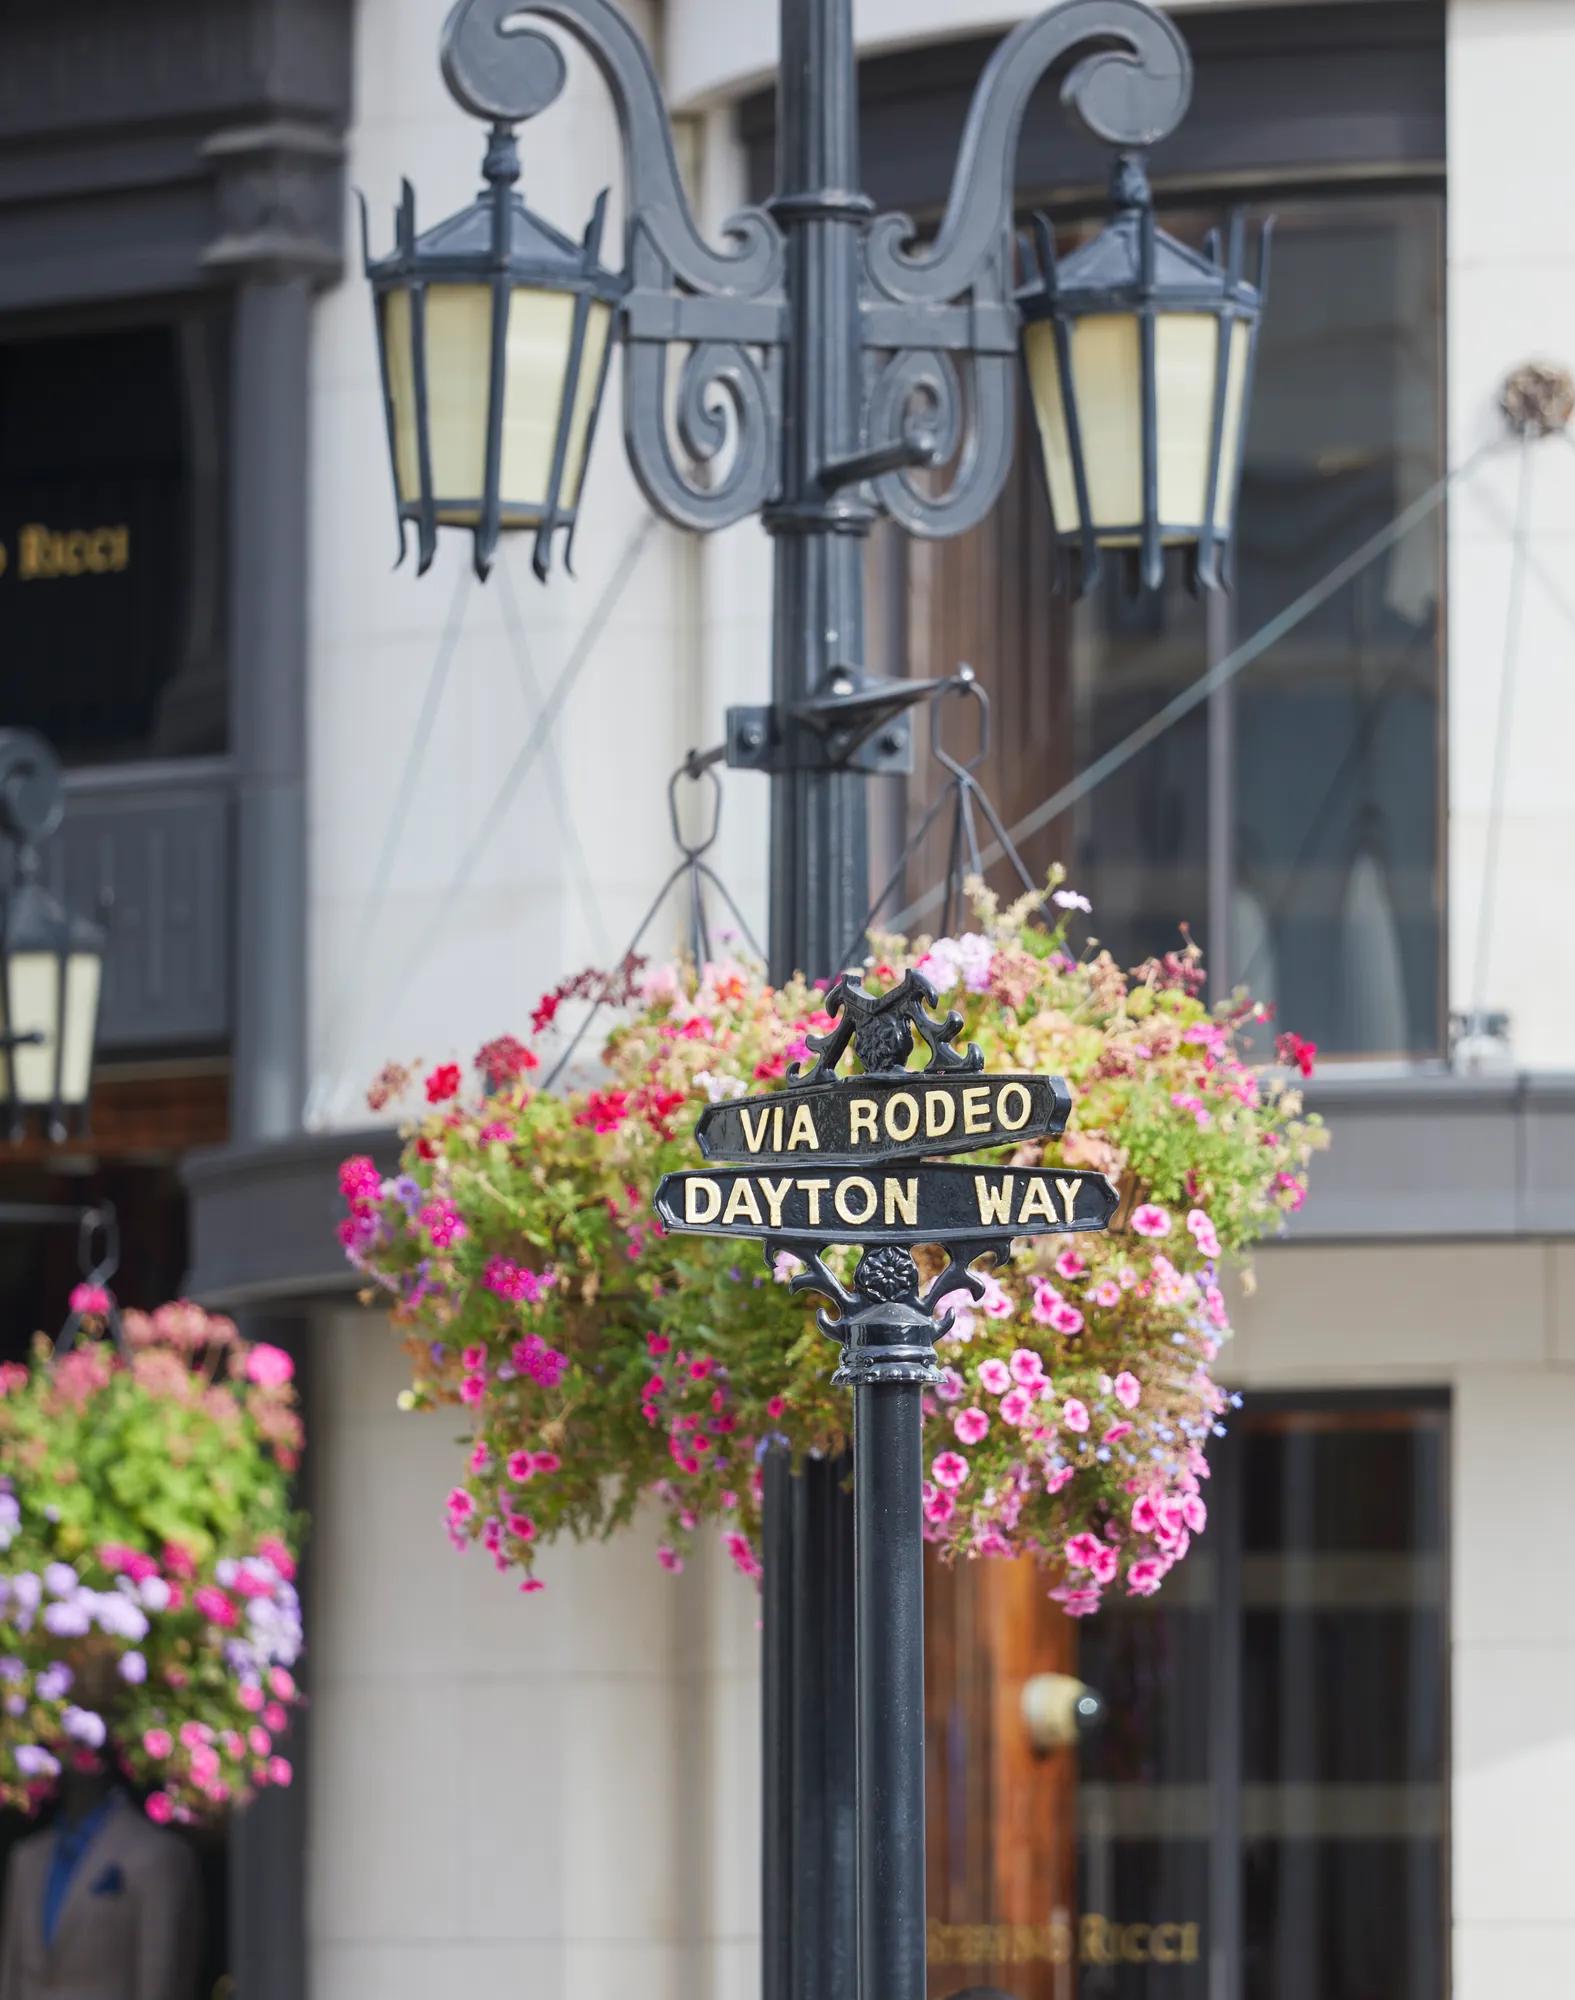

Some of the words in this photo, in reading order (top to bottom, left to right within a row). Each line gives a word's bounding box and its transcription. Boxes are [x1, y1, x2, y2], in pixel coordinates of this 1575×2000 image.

[740, 1104, 820, 1154] VIA
[850, 1082, 1033, 1146] RODEO
[685, 1176, 919, 1228] DAYTON
[974, 1175, 1083, 1226] WAY
